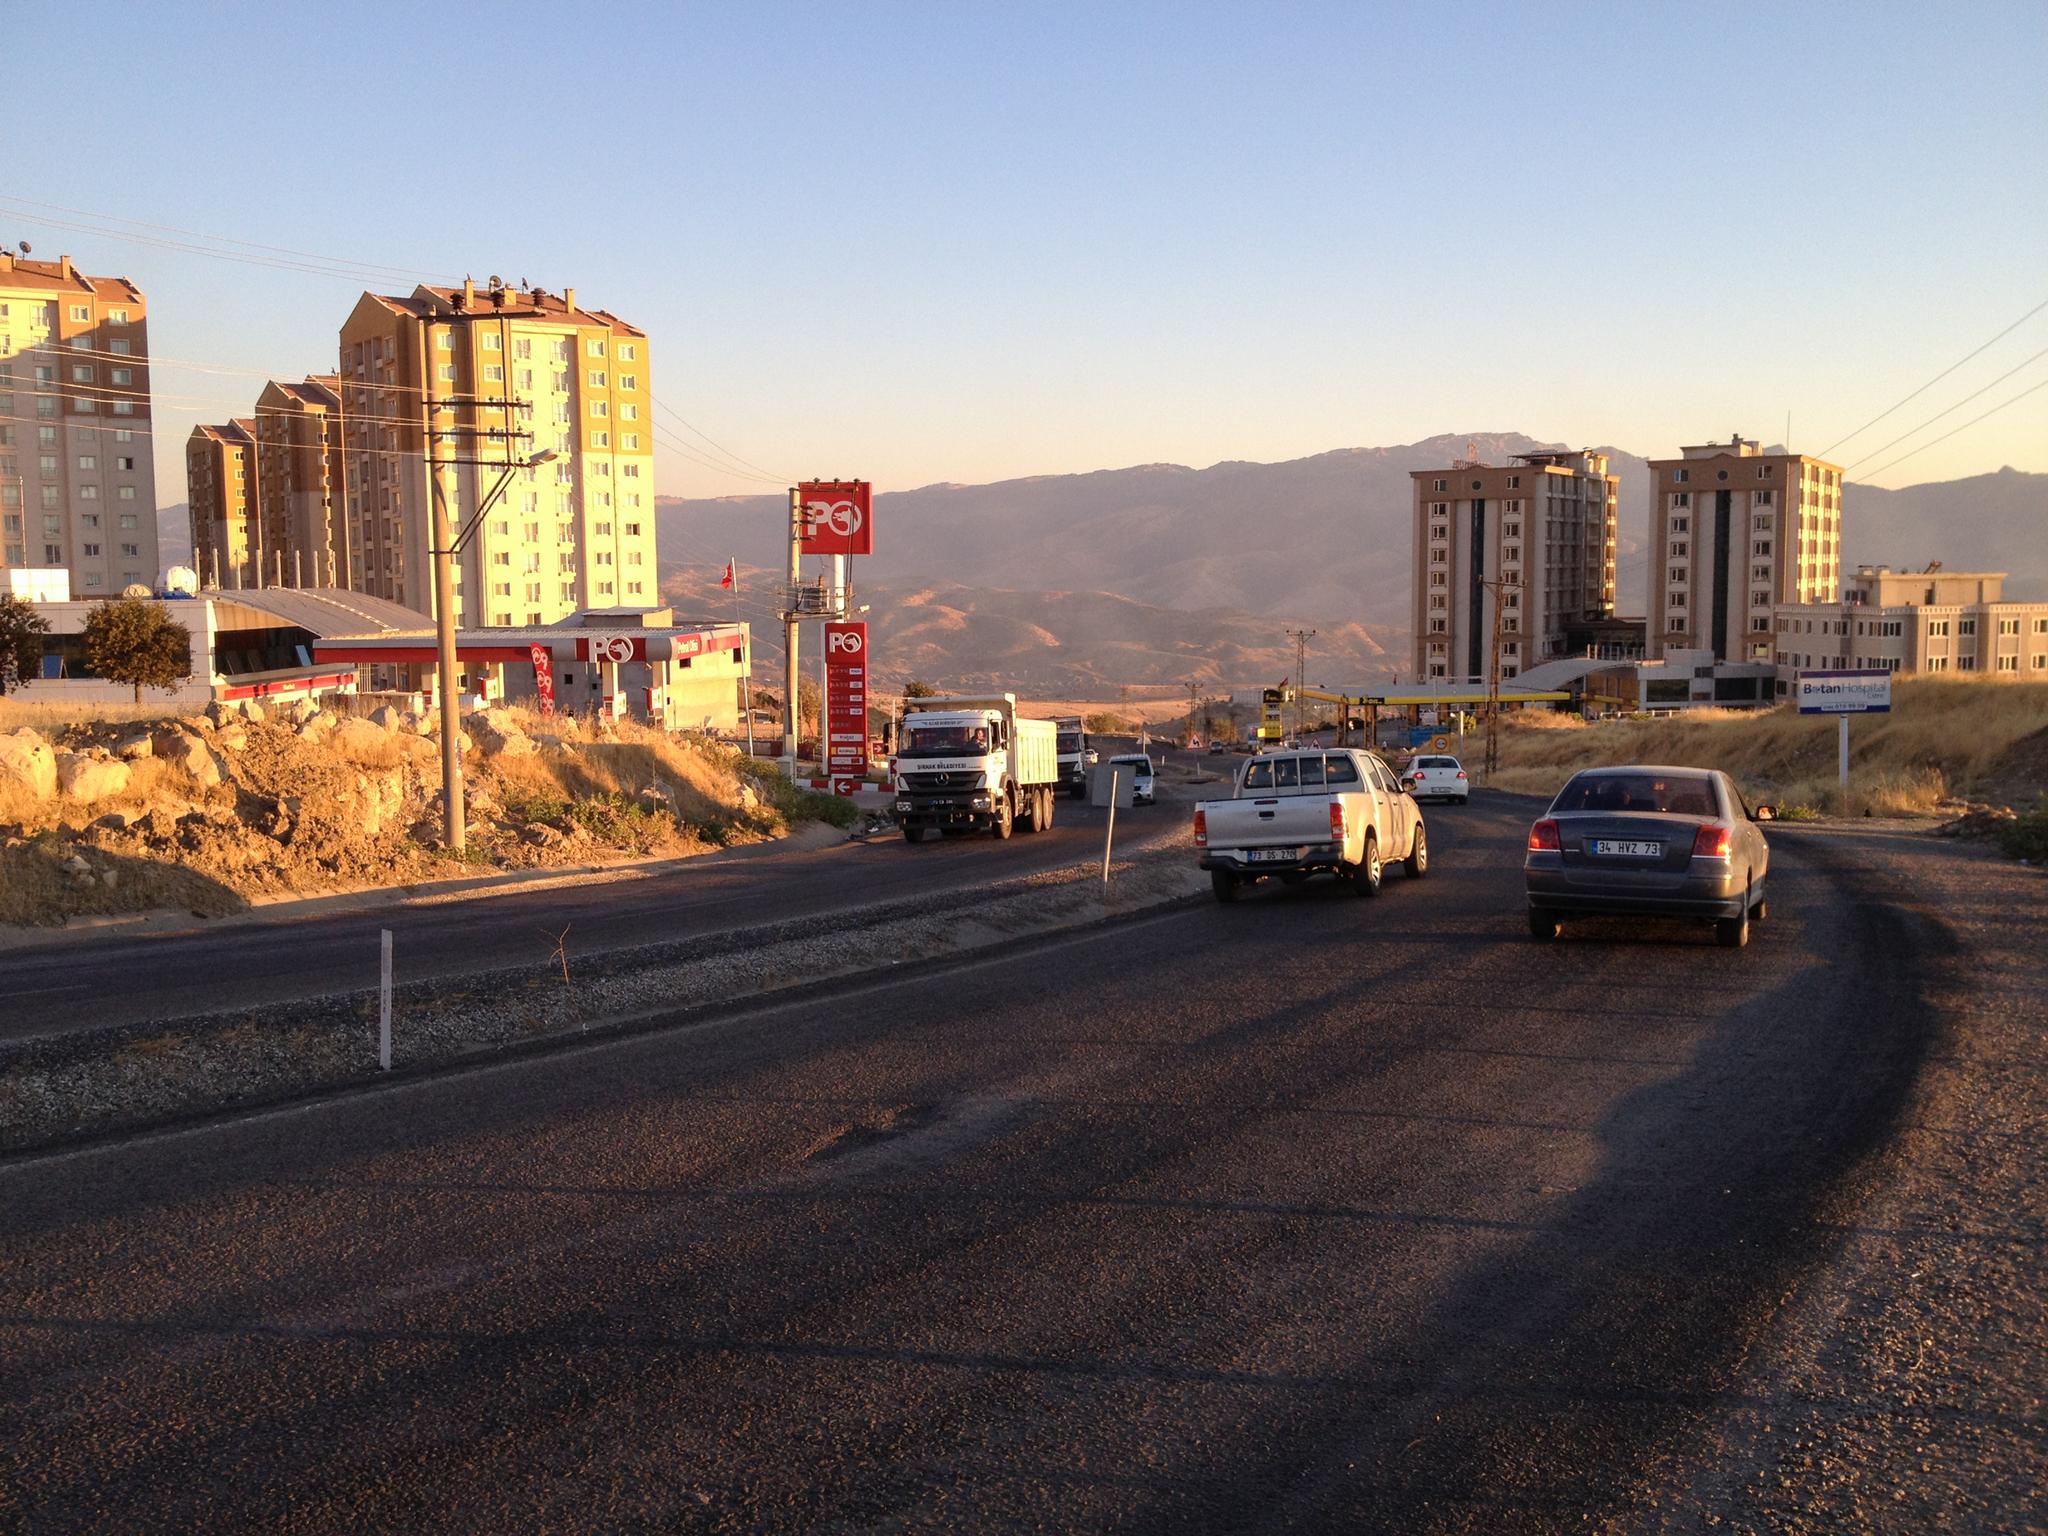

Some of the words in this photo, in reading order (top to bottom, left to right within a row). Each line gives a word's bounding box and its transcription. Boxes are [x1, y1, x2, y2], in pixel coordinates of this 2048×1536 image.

[588, 635, 634, 663] PO
[829, 632, 862, 653] PO
[1599, 842, 1611, 853] 34
[1618, 842, 1638, 854] HVZ
[1645, 843, 1659, 855] 73
